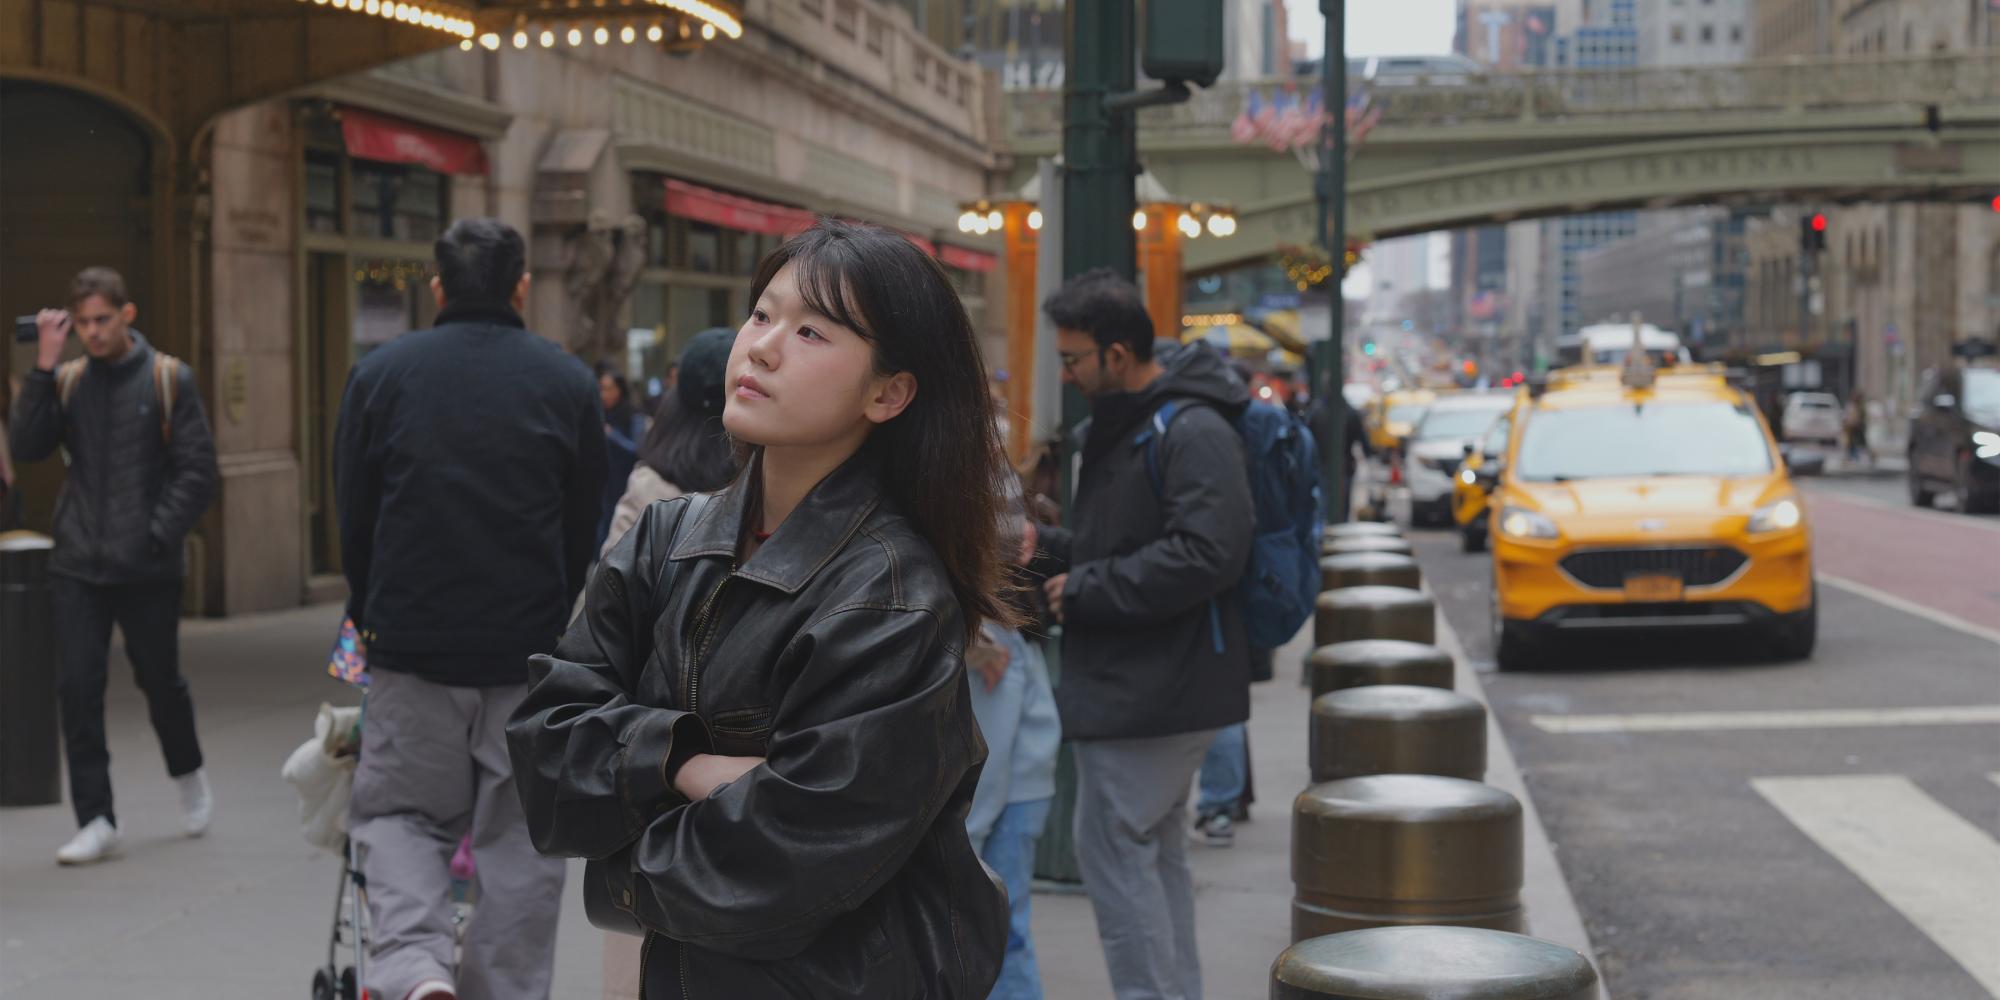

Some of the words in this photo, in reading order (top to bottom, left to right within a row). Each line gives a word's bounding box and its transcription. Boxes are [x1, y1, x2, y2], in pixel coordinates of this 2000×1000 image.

[1271, 190, 1401, 235] GRND
[1422, 163, 1593, 206] CENTRAL
[1622, 147, 1817, 184] TERMINAL
